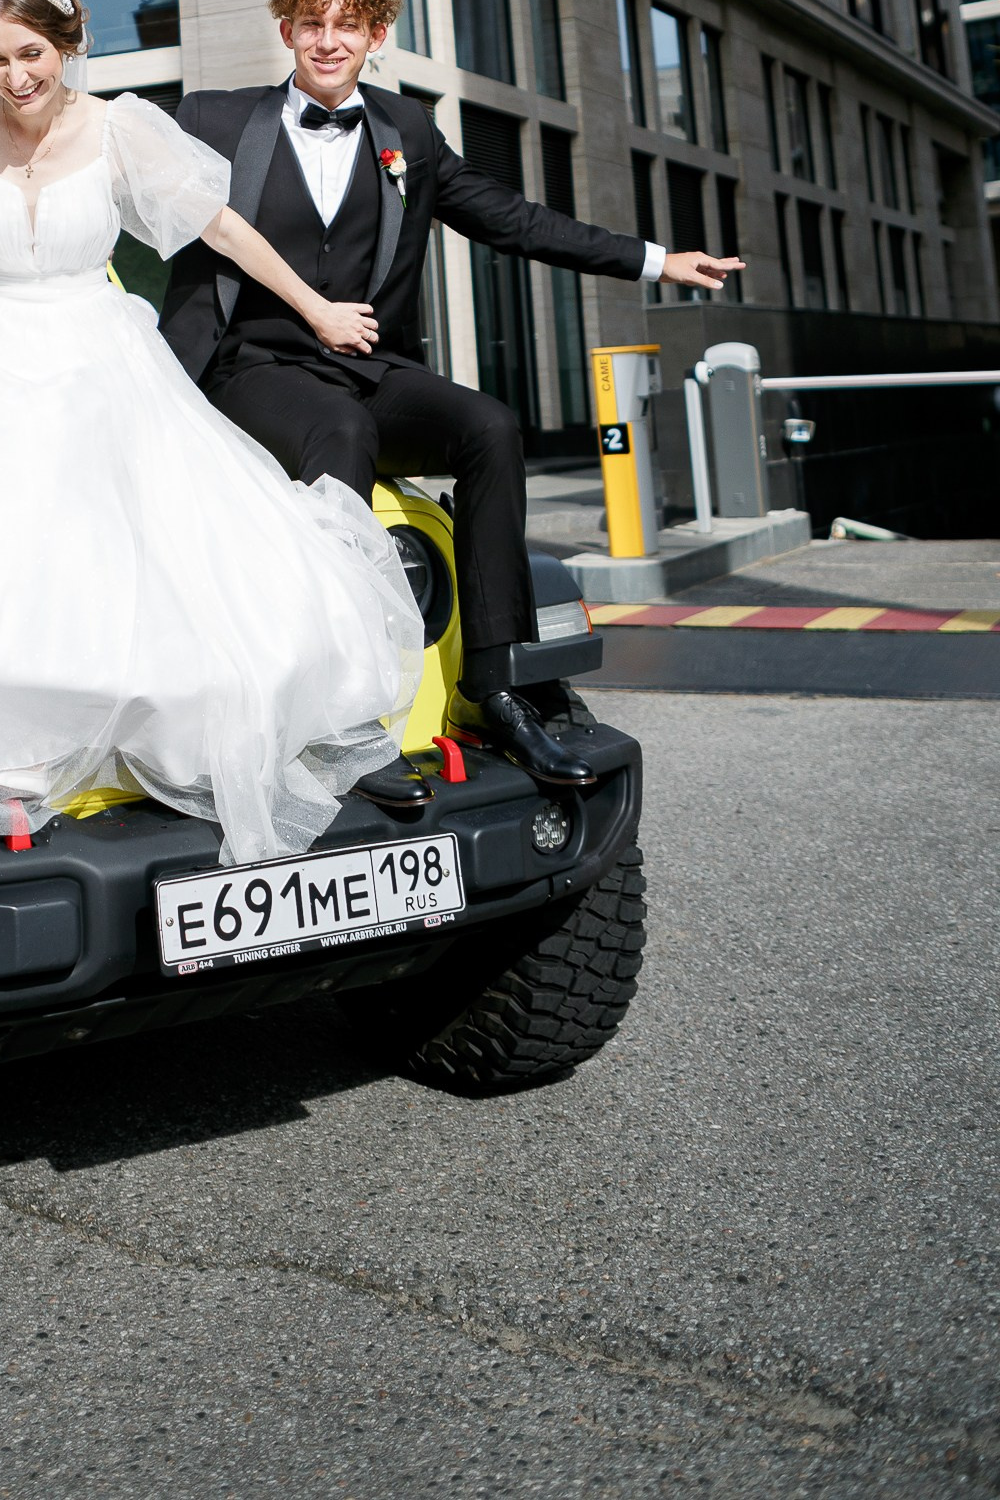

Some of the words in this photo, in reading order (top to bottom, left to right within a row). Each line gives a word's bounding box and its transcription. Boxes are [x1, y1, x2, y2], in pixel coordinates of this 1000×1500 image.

[600, 357, 611, 392] CAME
[177, 871, 371, 950] E691ME
[378, 845, 443, 895] 198
[405, 892, 438, 912] RUS
[179, 963, 197, 974] ARB
[233, 948, 269, 964] TUNING
[269, 942, 302, 957] CENTER
[320, 922, 408, 948] WWW.ARBTRAVEL.RU
